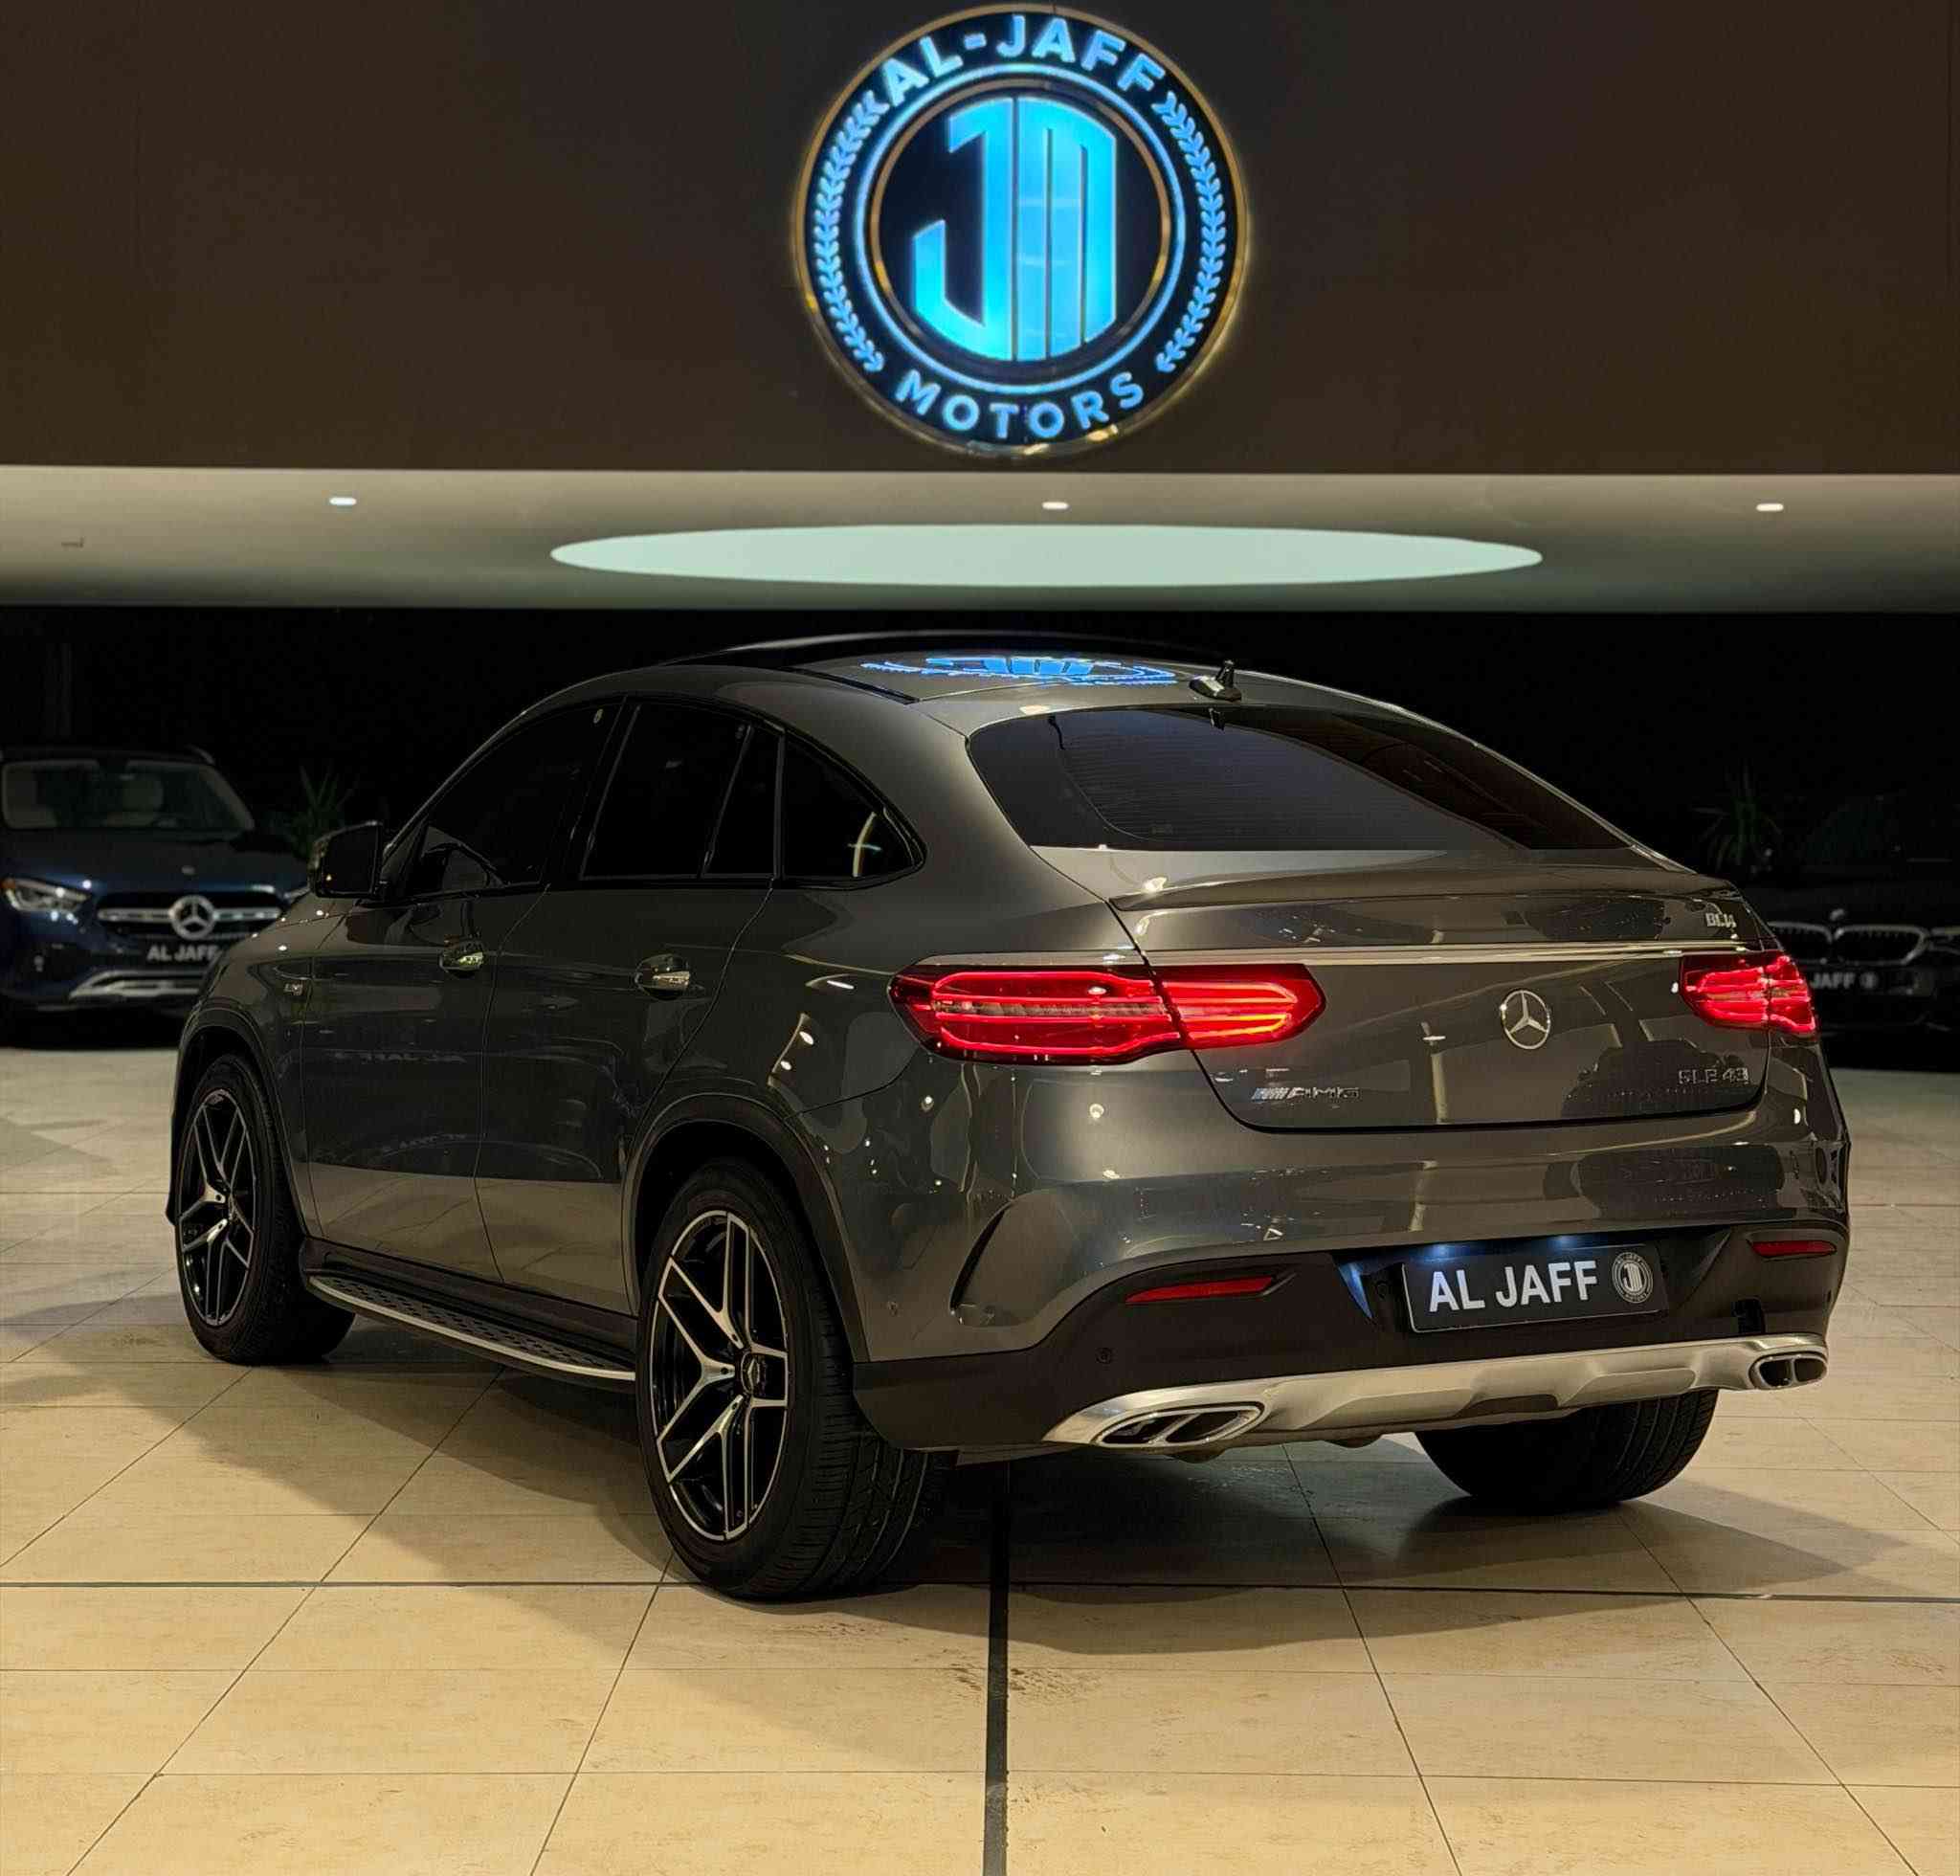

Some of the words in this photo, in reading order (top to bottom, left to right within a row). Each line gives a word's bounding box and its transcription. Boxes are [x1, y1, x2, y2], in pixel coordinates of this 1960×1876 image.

[880, 15, 1165, 104] AL-JAFF
[896, 369, 1145, 438] MOTORS
[147, 945, 172, 961] AL
[1723, 1067, 1748, 1084] 43
[1429, 1270, 1485, 1312] AL
[1496, 1260, 1597, 1307] JAFF
